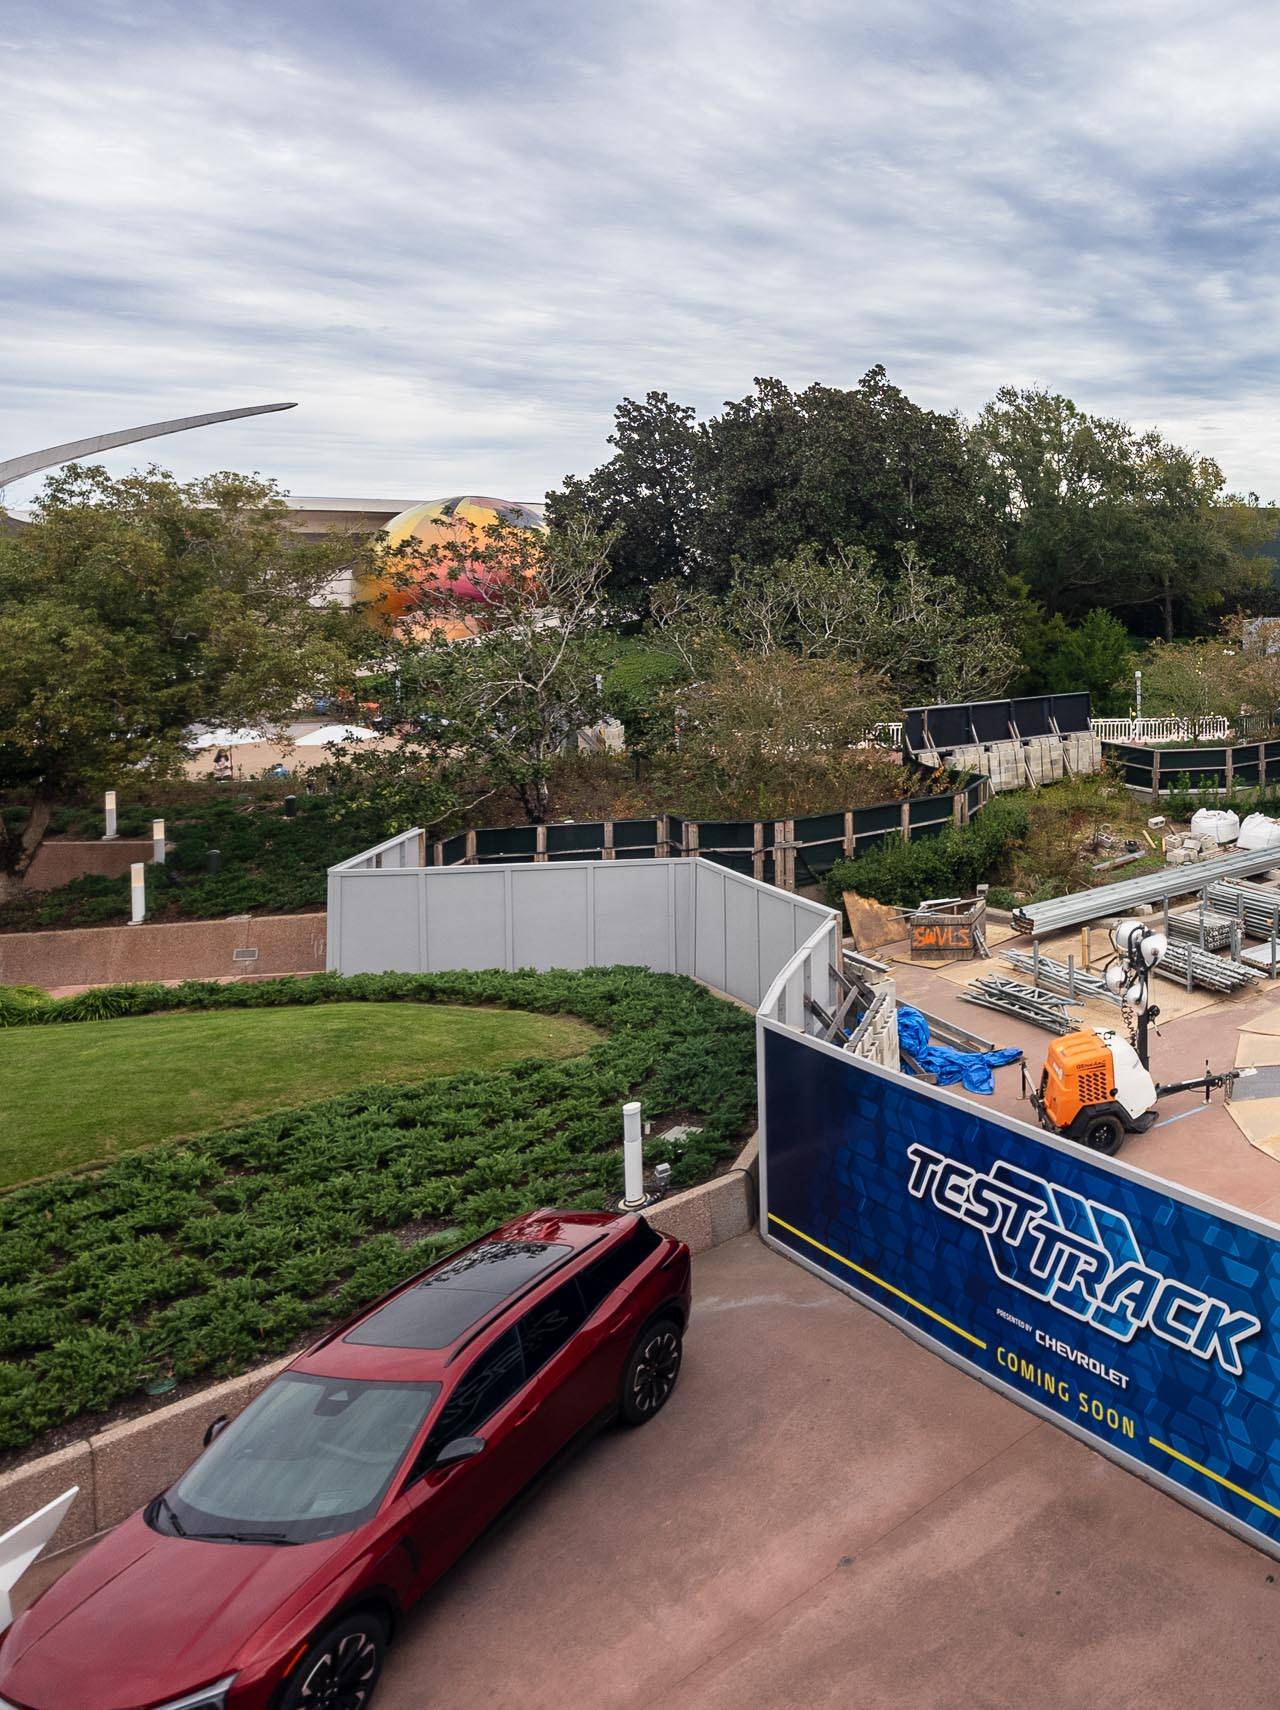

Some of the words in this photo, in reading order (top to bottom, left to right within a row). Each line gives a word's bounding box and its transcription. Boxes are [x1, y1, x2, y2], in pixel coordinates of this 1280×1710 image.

[907, 1143, 1048, 1247] TEST
[1028, 1217, 1261, 1376] TRACK
[997, 1346, 1069, 1402] COMING
[1079, 1392, 1135, 1439] SOON
[1035, 1329, 1129, 1389] CHEVROLET
